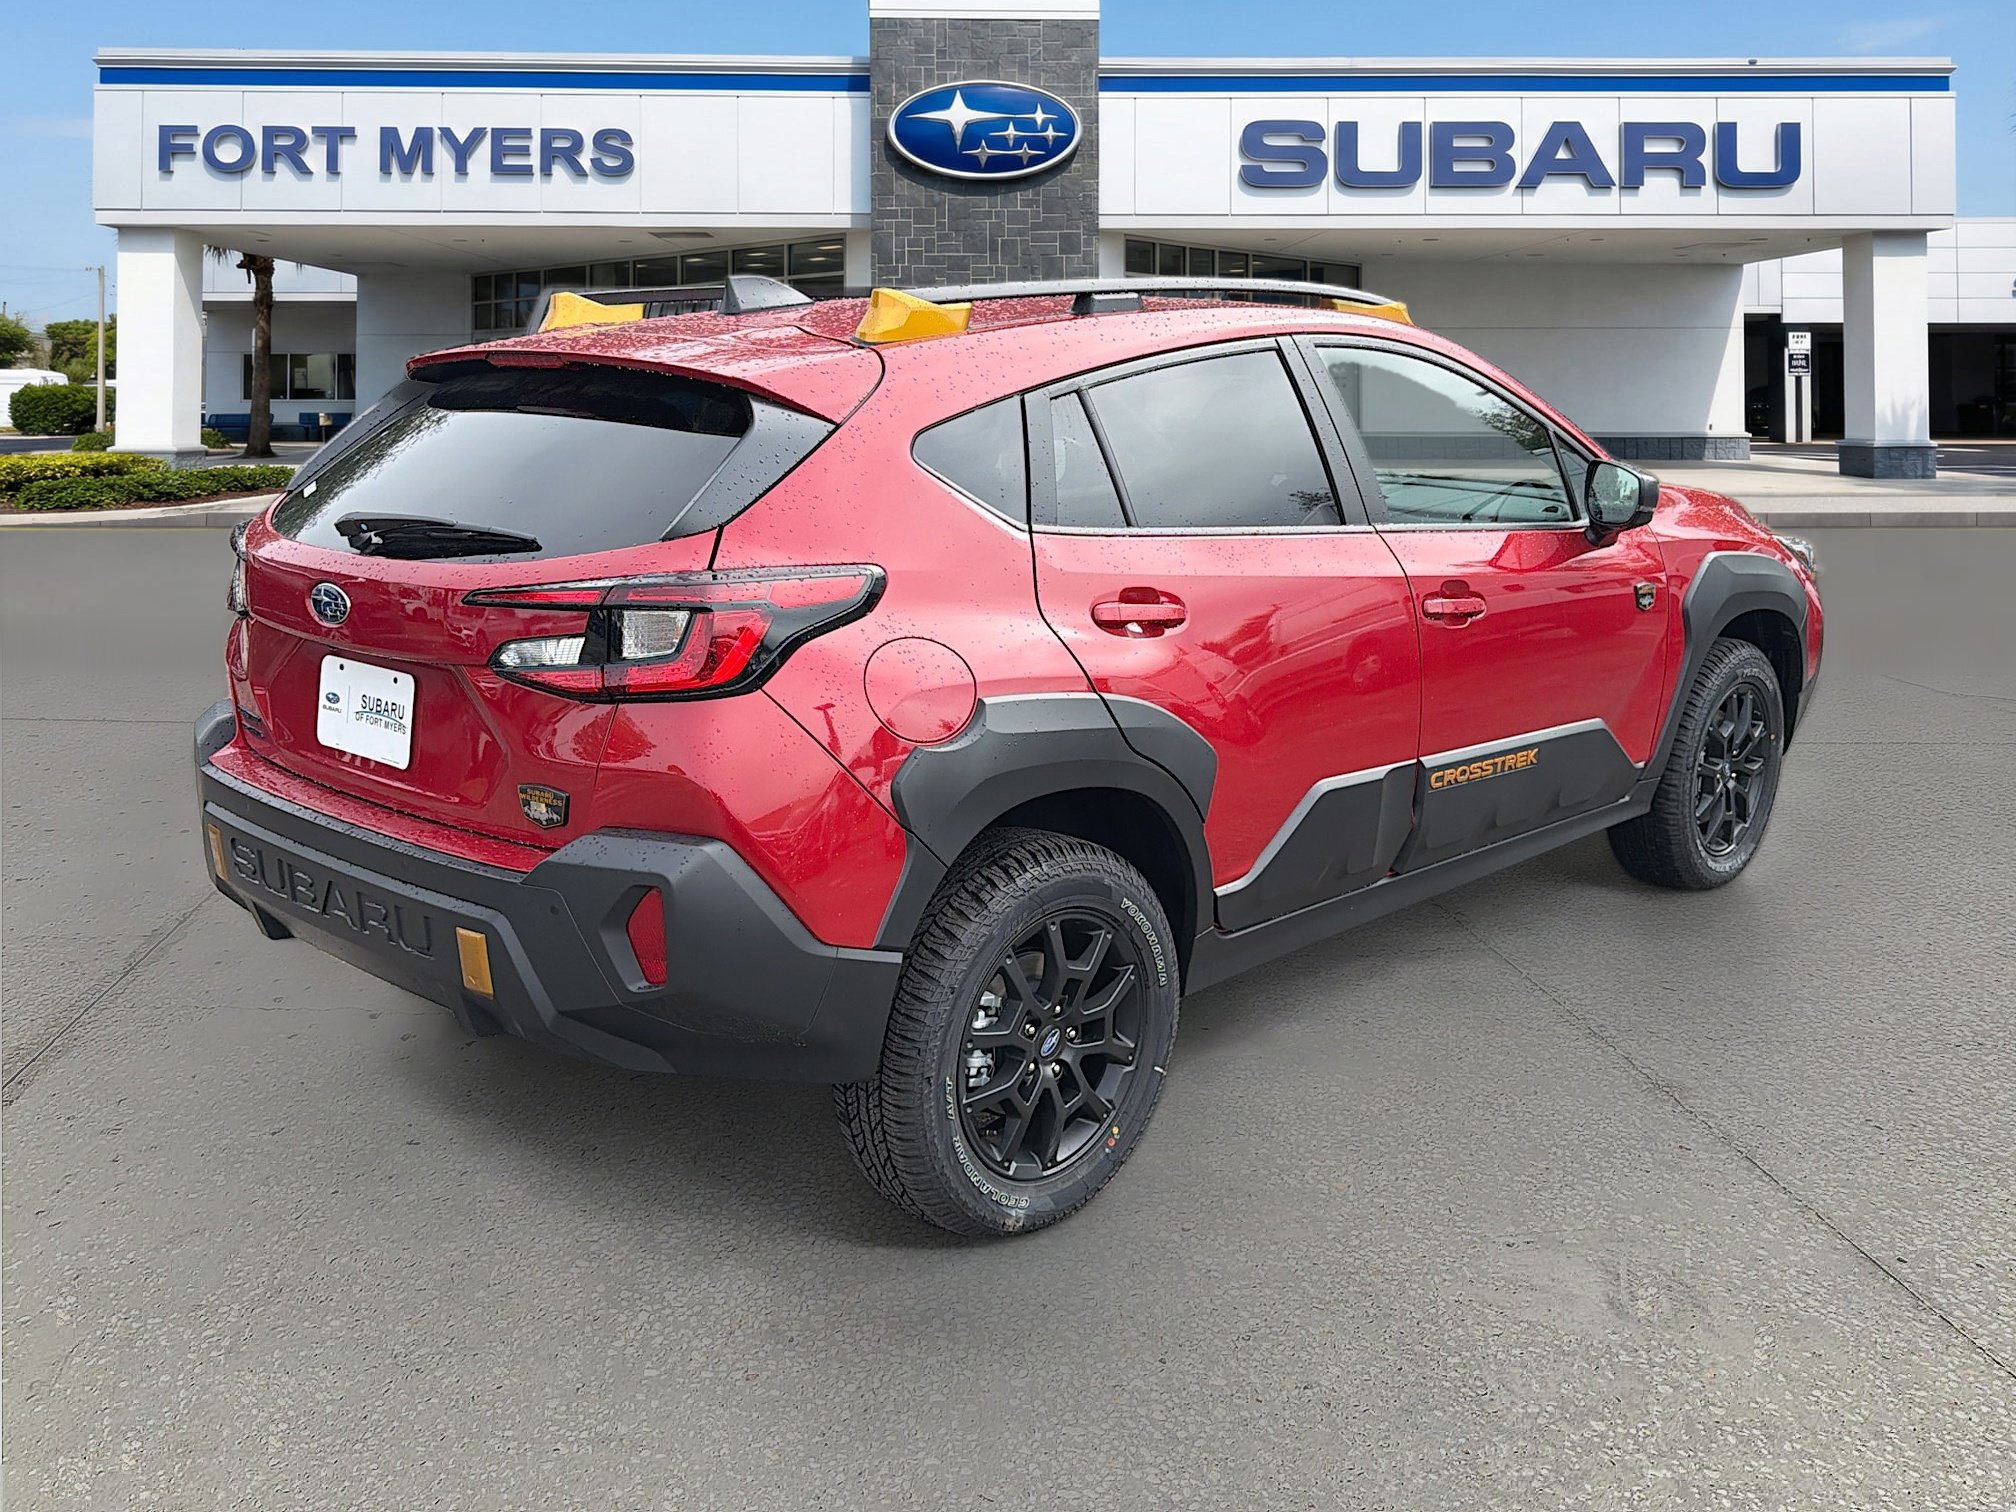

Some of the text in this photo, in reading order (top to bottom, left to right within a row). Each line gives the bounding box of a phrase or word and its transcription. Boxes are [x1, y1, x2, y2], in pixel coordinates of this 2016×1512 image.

[157, 124, 636, 178] FORT MYERS
[1239, 119, 1802, 190] SUBARU
[354, 711, 407, 735] OF FORT MYERS
[360, 694, 405, 720] SUBARU
[1430, 748, 1539, 789] CROSSTREK
[230, 837, 434, 961] SUBARU
[1120, 896, 1169, 987] YOKOHAMA
[952, 1135, 1031, 1208] GEOLANDAR
